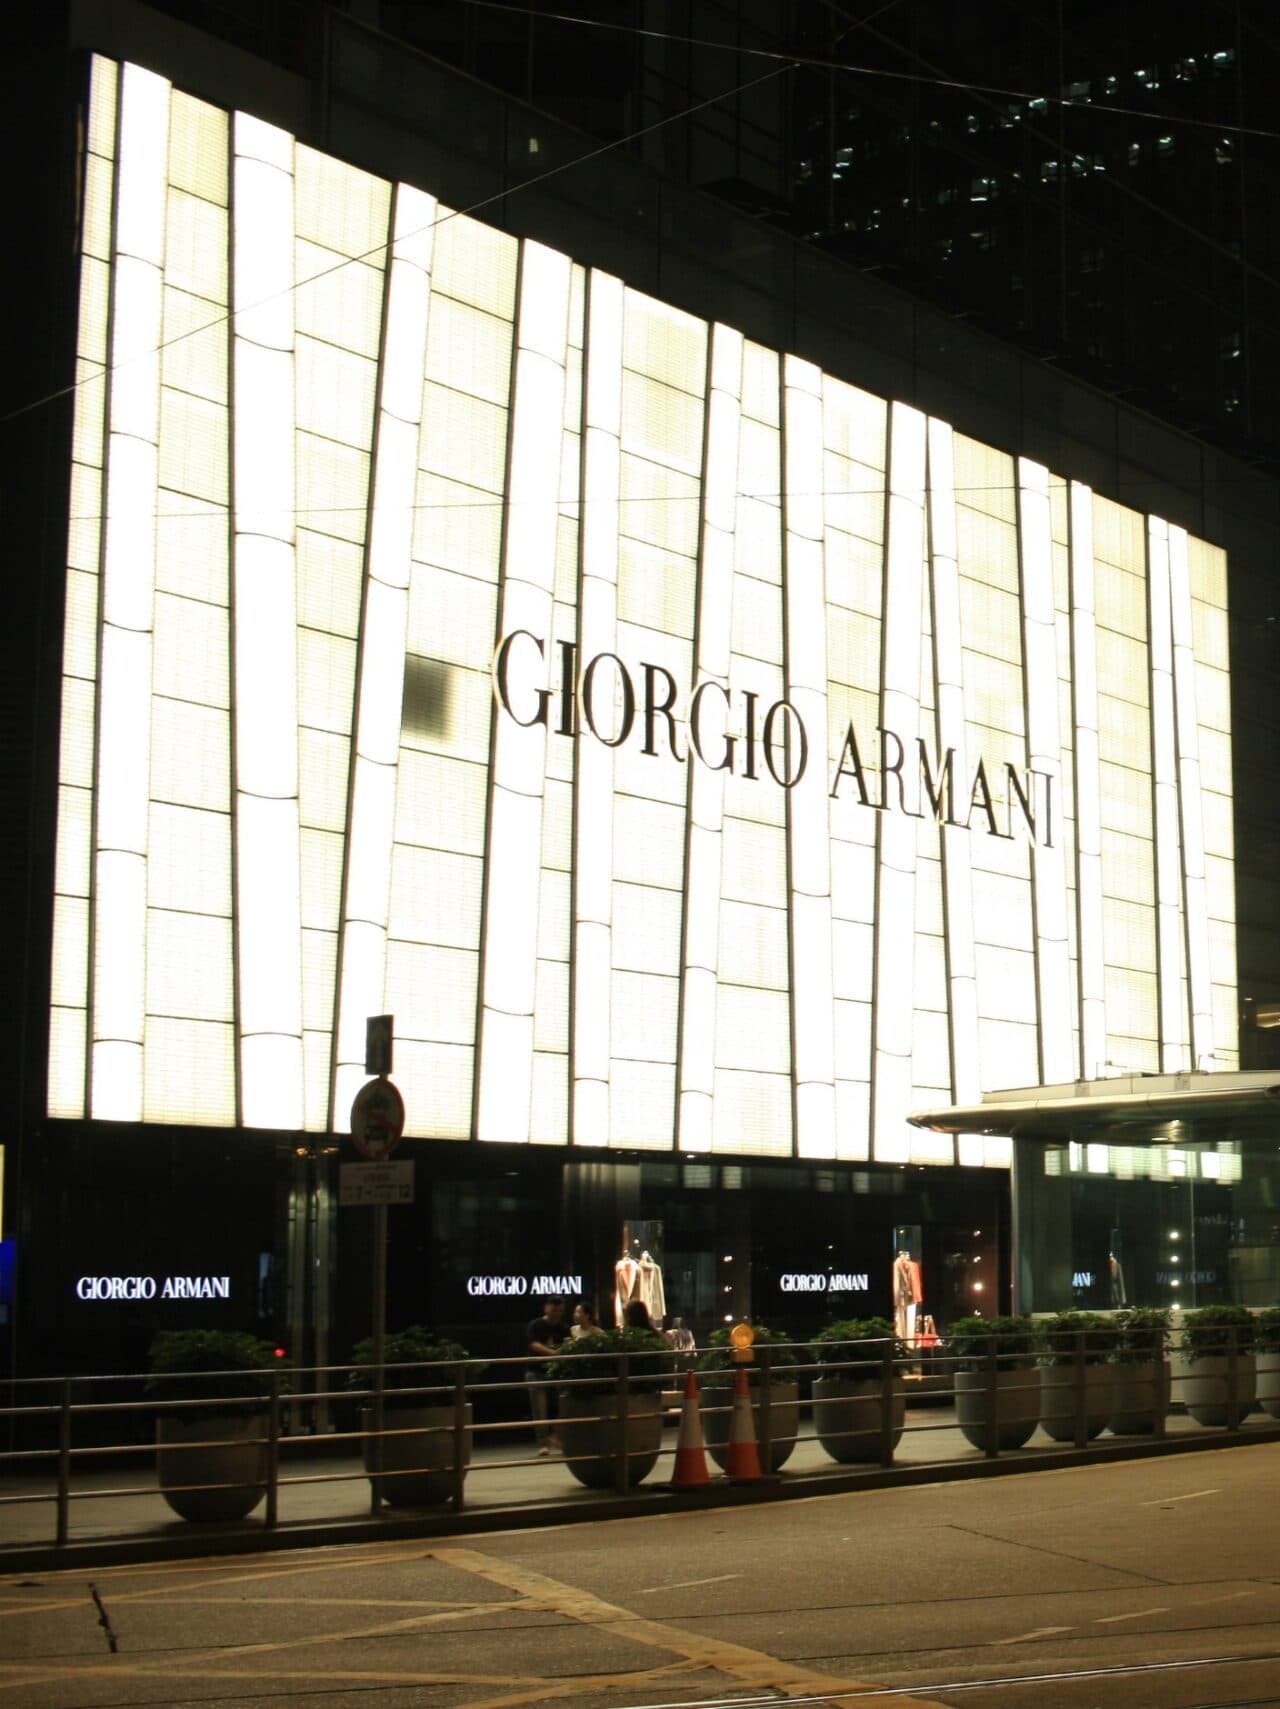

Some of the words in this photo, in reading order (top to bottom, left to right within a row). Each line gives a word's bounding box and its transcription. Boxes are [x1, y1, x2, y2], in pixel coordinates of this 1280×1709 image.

[496, 629, 809, 789] GIORGIO
[829, 718, 1056, 849] ARMANI
[76, 1276, 157, 1300] GIORGIO
[160, 1276, 231, 1299] ARMANI
[466, 1275, 528, 1296] GIORGIO
[530, 1275, 583, 1295] ARMANI
[779, 1274, 827, 1292] GIORGIO
[828, 1273, 869, 1292] ARMANI
